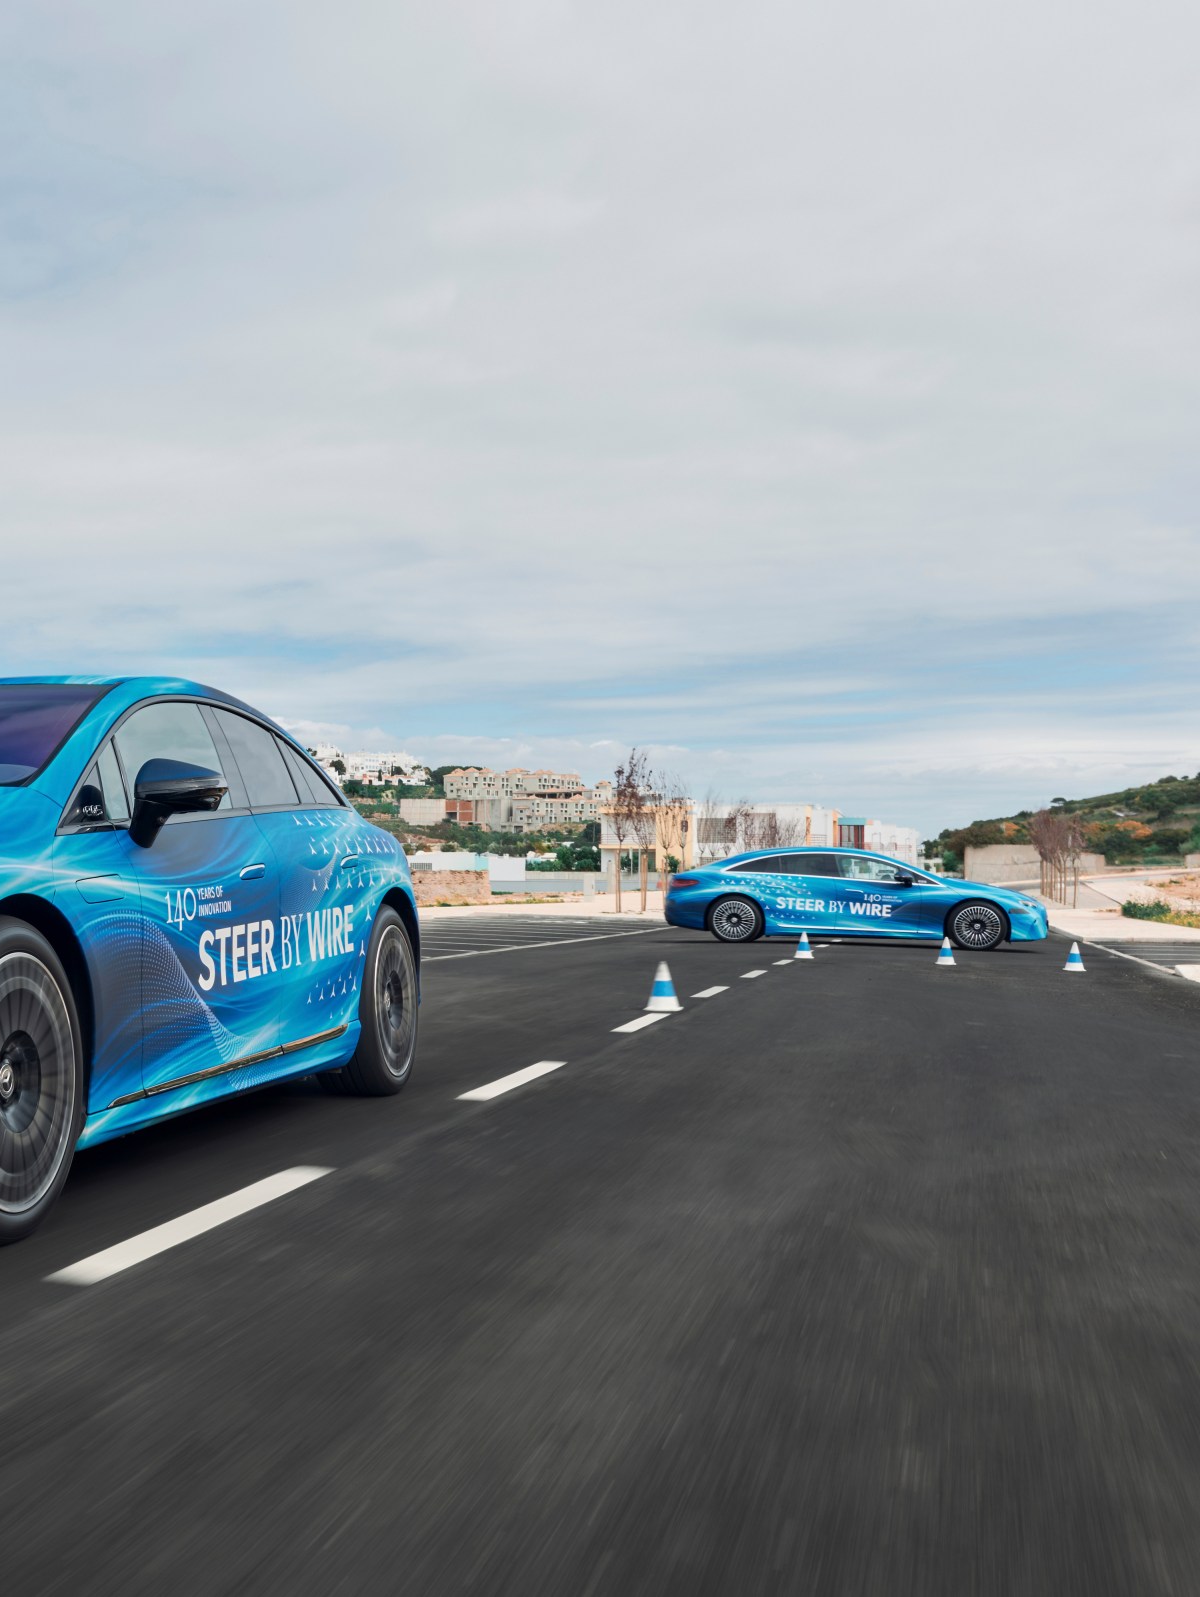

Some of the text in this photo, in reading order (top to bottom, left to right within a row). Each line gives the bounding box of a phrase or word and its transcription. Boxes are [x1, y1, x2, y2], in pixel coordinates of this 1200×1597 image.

[197, 885, 224, 900] YEARS OF
[864, 893, 882, 903] 140
[165, 887, 197, 931] 140
[198, 901, 232, 917] INNOVATION
[776, 896, 892, 917] STEER BY WIRE
[198, 904, 354, 991] STEER BY WIRE
